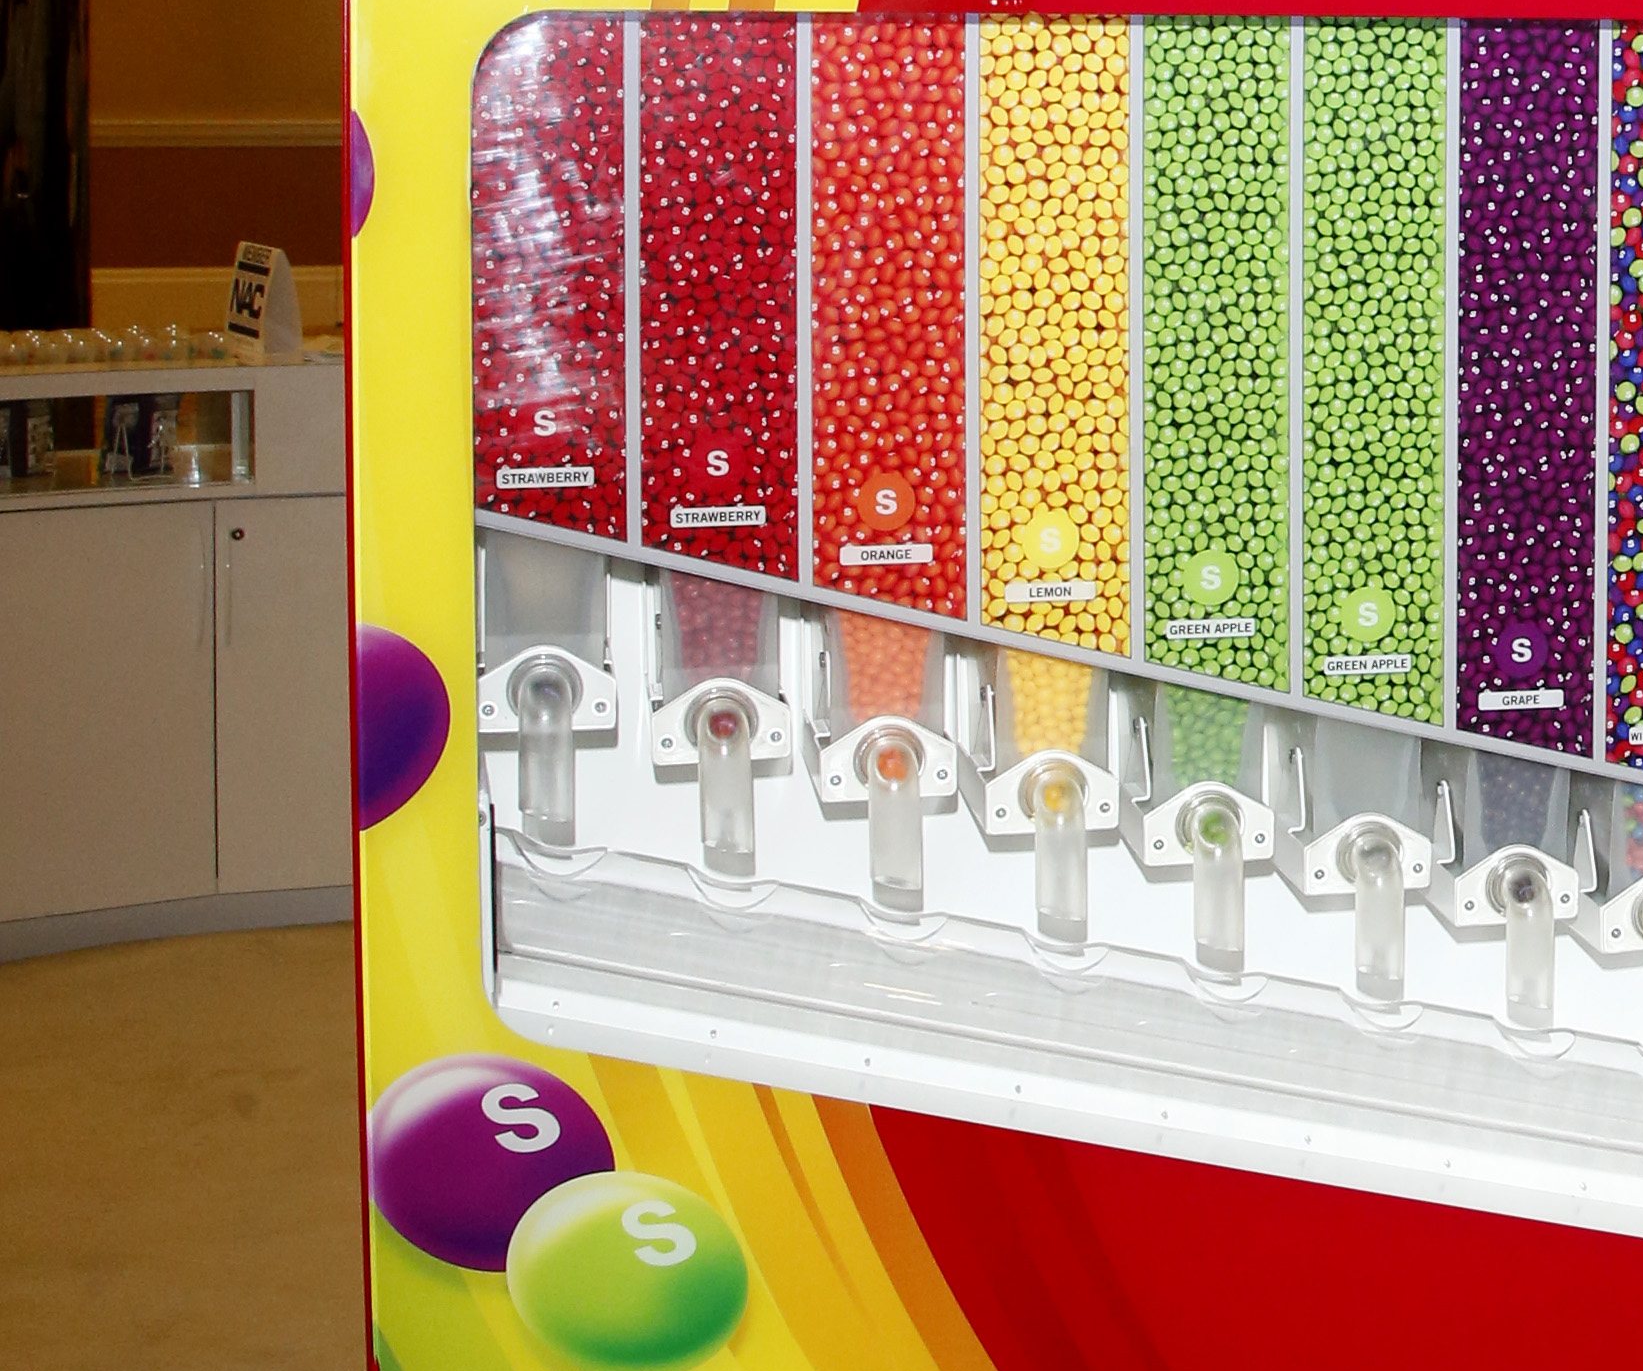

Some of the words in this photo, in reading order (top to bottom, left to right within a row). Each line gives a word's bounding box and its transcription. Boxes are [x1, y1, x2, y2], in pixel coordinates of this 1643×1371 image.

[231, 278, 265, 319] NAC
[501, 470, 591, 488] STRAWBERRY
[674, 509, 762, 526] STRAWBERRY
[860, 547, 913, 562] ORANGE
[1028, 584, 1073, 599] LEMON
[1169, 621, 1212, 636] GREEN
[1214, 619, 1252, 634] APPLE
[1327, 658, 1369, 672] GREEN
[1372, 656, 1409, 670] APPLE
[1501, 693, 1541, 707] GRAPE
[481, 1083, 561, 1153] S
[621, 1200, 698, 1267] S
